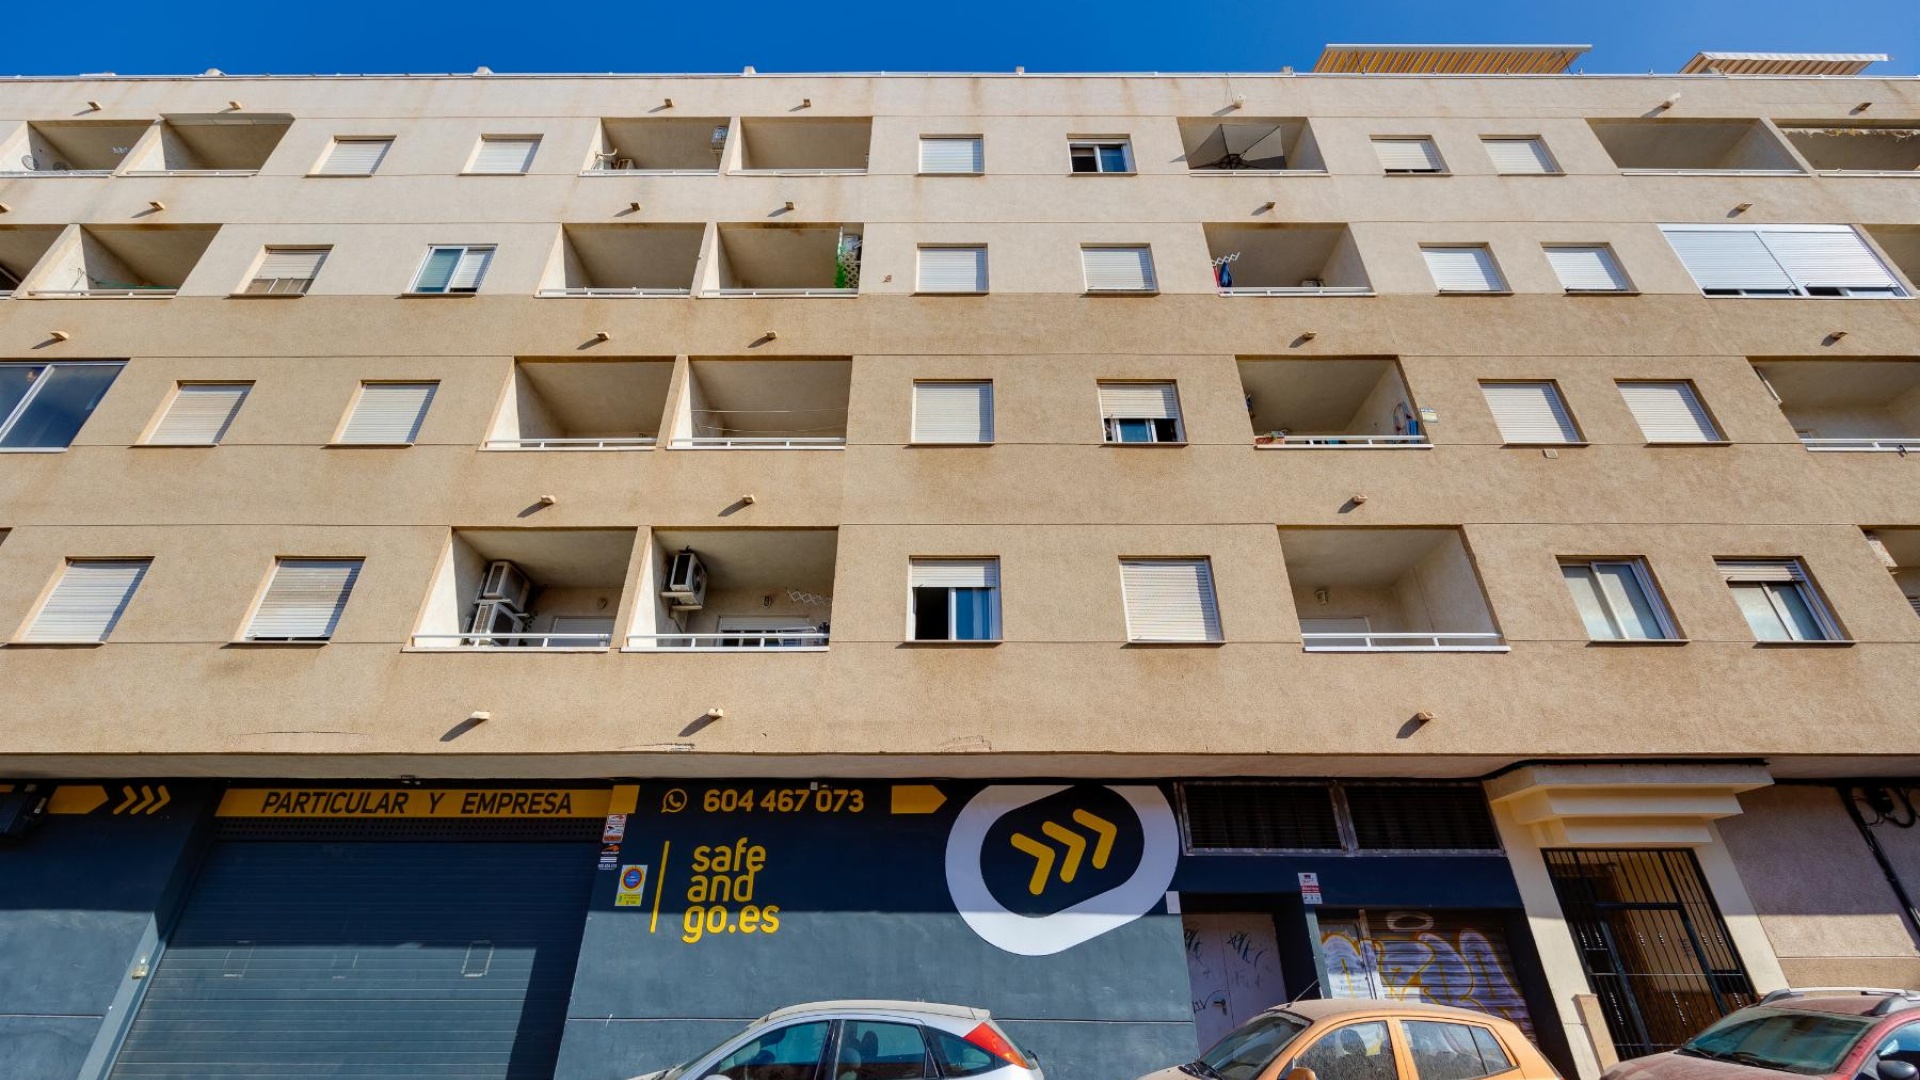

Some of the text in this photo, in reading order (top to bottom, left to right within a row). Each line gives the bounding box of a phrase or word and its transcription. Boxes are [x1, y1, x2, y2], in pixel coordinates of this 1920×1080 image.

[260, 791, 572, 815] PARTICULAR Y EMPRESA
[703, 789, 864, 813] 604 467 073
[691, 837, 767, 873] safe
[687, 871, 755, 903] and
[682, 904, 780, 944] go.es
